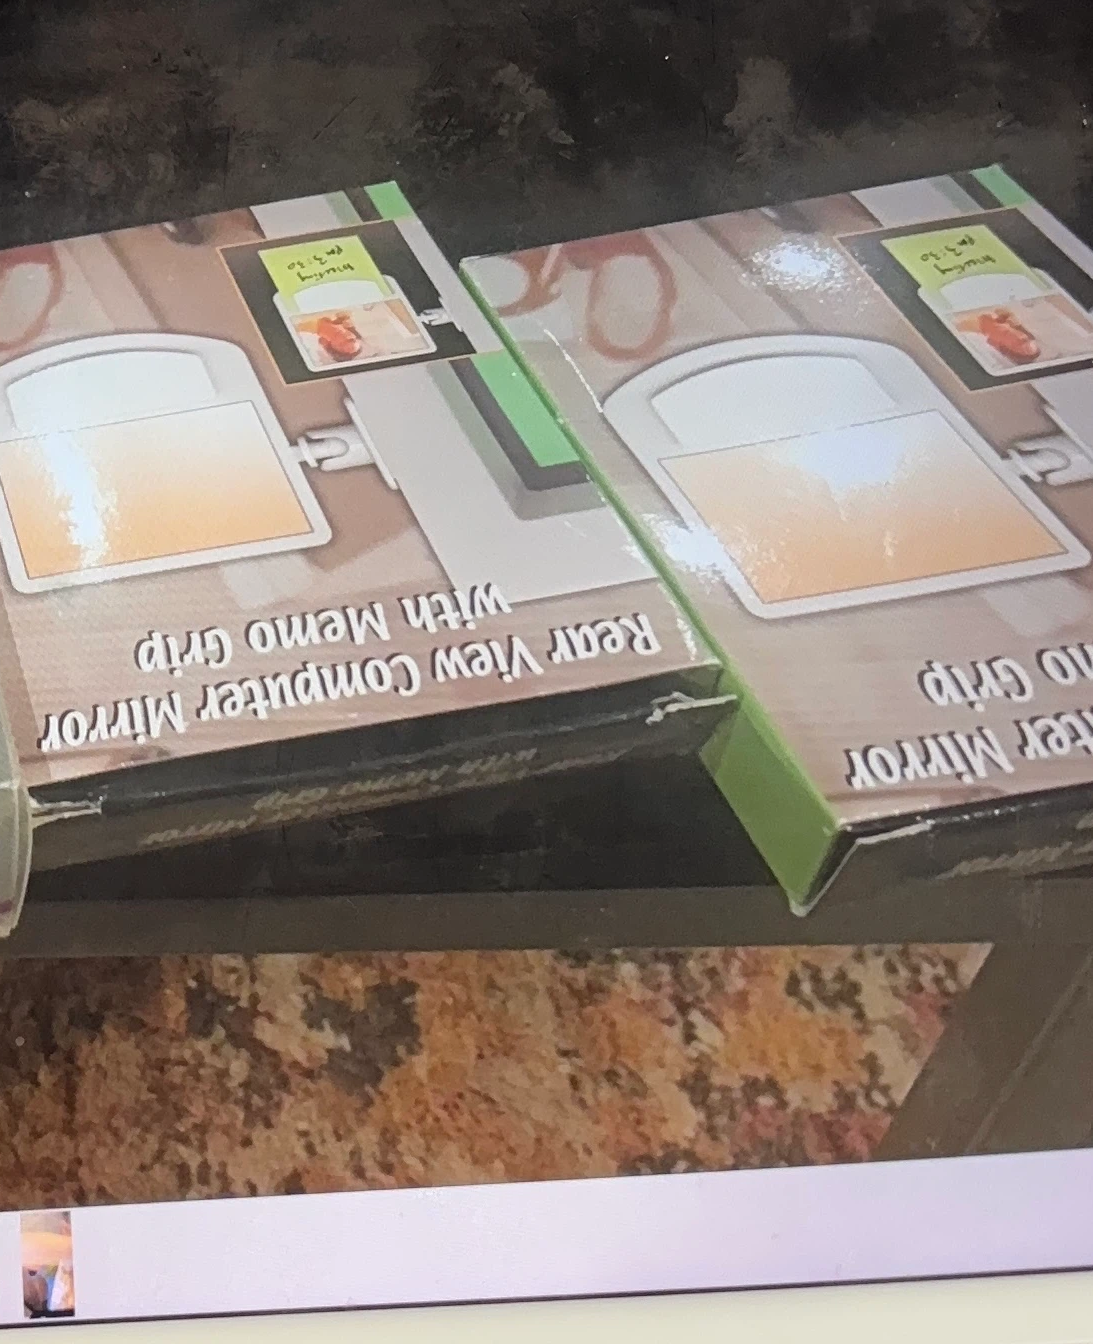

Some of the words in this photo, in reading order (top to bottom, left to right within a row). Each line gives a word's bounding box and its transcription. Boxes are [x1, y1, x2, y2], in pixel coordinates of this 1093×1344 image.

[245, 601, 392, 653] Memo
[401, 582, 512, 634] with
[134, 626, 233, 677] Grip
[432, 635, 544, 683] View
[548, 612, 662, 664] Rear
[197, 653, 421, 721] Computer
[917, 656, 1033, 713] Grip
[37, 690, 187, 753] Mirror
[844, 726, 1015, 791] Mirror
